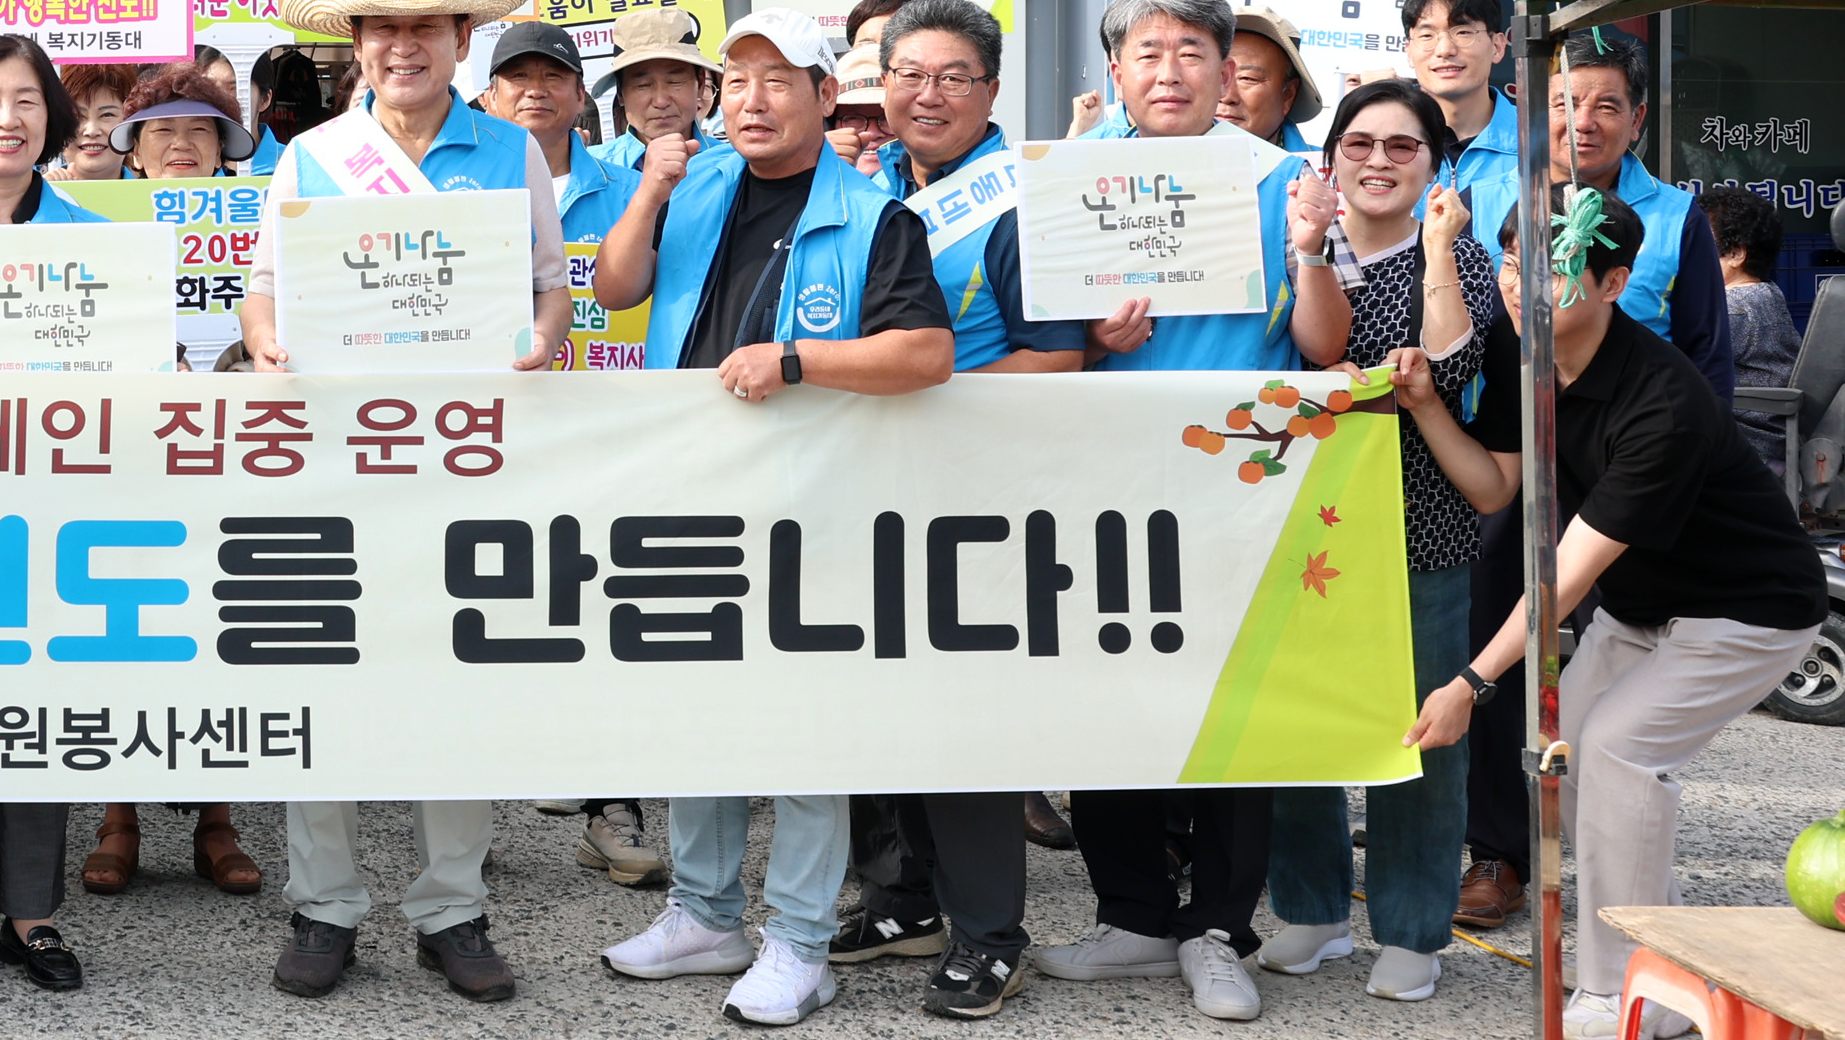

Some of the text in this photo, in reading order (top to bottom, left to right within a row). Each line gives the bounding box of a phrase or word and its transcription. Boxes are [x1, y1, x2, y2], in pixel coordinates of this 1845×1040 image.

[46, 30, 142, 51] 복지기동대
[1300, 29, 1380, 51] 대한민국을
[154, 189, 268, 224] 힘겨울
[1081, 174, 1196, 231] 온기나눔
[1118, 214, 1168, 234] 하나되는
[183, 231, 260, 265] 20번
[1129, 235, 1182, 258] 대한민국
[343, 230, 466, 290] 온기나눔
[381, 272, 435, 293] 하나되는
[1085, 270, 1205, 286] 더 따뜻한 대한민국을 만듭니다!
[176, 276, 244, 311] 화주
[24, 302, 77, 323] 하나되는
[392, 294, 449, 317] 대한민국
[35, 325, 91, 347] 대한민국
[343, 329, 471, 347] 더 따뜻한 대한민국을 만듭니다!
[154, 398, 315, 478] 집중
[345, 397, 505, 477] 운영
[445, 509, 1185, 664] 만듭니다!!
